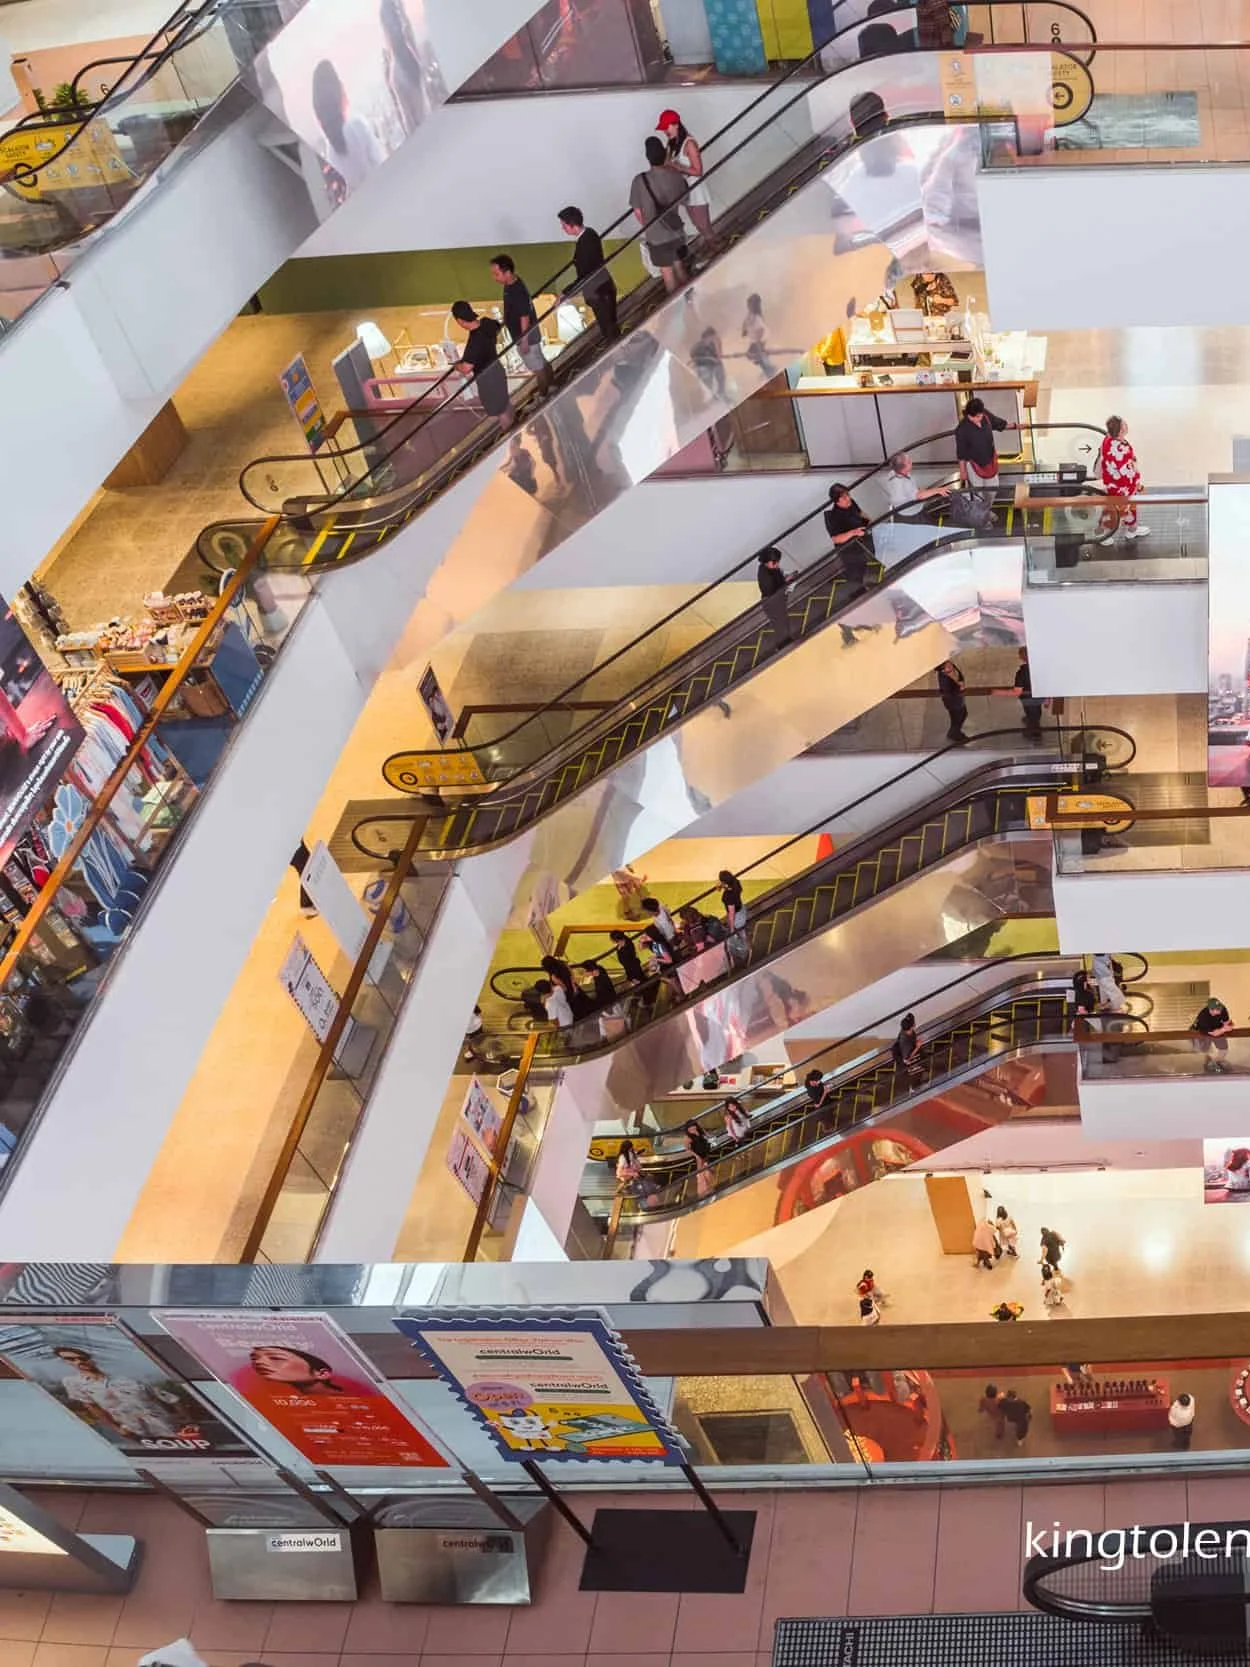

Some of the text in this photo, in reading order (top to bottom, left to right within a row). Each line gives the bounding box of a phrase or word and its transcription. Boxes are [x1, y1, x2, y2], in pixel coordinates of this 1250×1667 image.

[1051, 23, 1060, 36] 6
[140, 1438, 211, 1450] SOUP
[271, 1537, 337, 1548] centralwOrld
